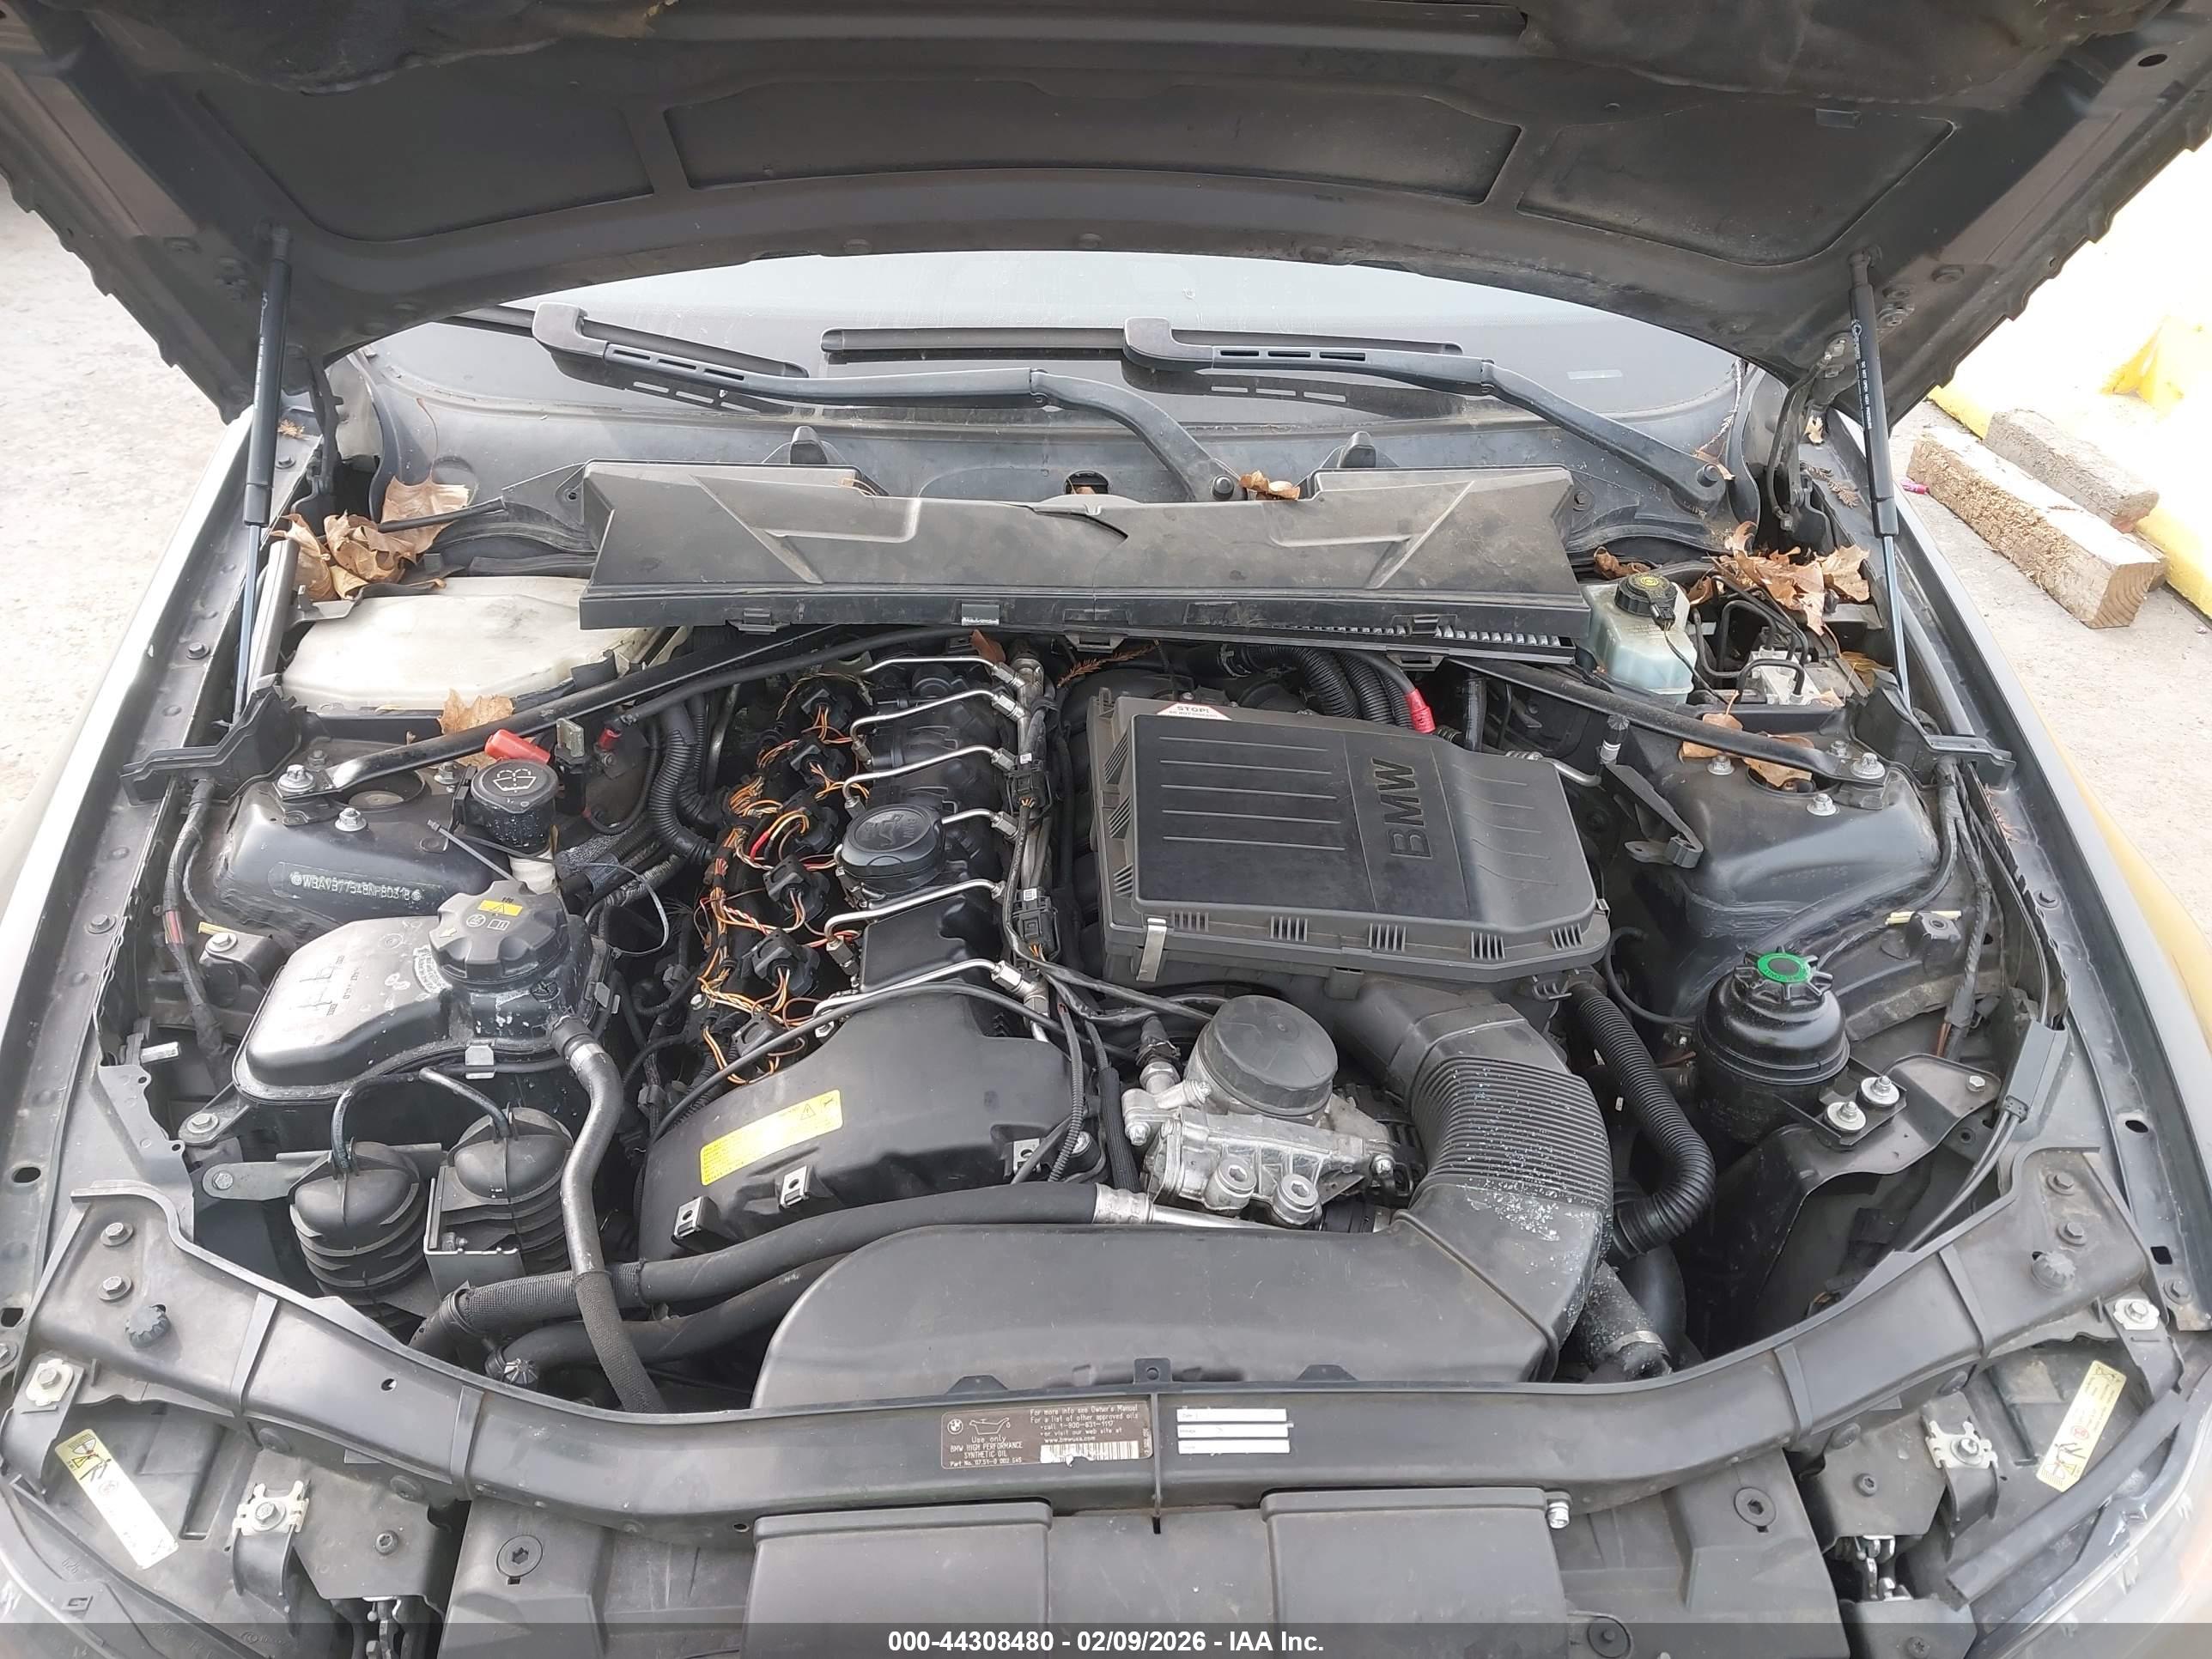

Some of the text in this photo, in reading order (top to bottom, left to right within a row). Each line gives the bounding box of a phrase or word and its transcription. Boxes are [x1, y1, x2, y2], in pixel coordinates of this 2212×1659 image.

[1371, 757, 1432, 859] BMW
[1116, 1403, 1138, 1412] Manual
[1127, 1412, 1138, 1420] oils
[982, 1442, 1023, 1450] PERFORMANCE
[963, 1450, 995, 1459] SYNTHETIC
